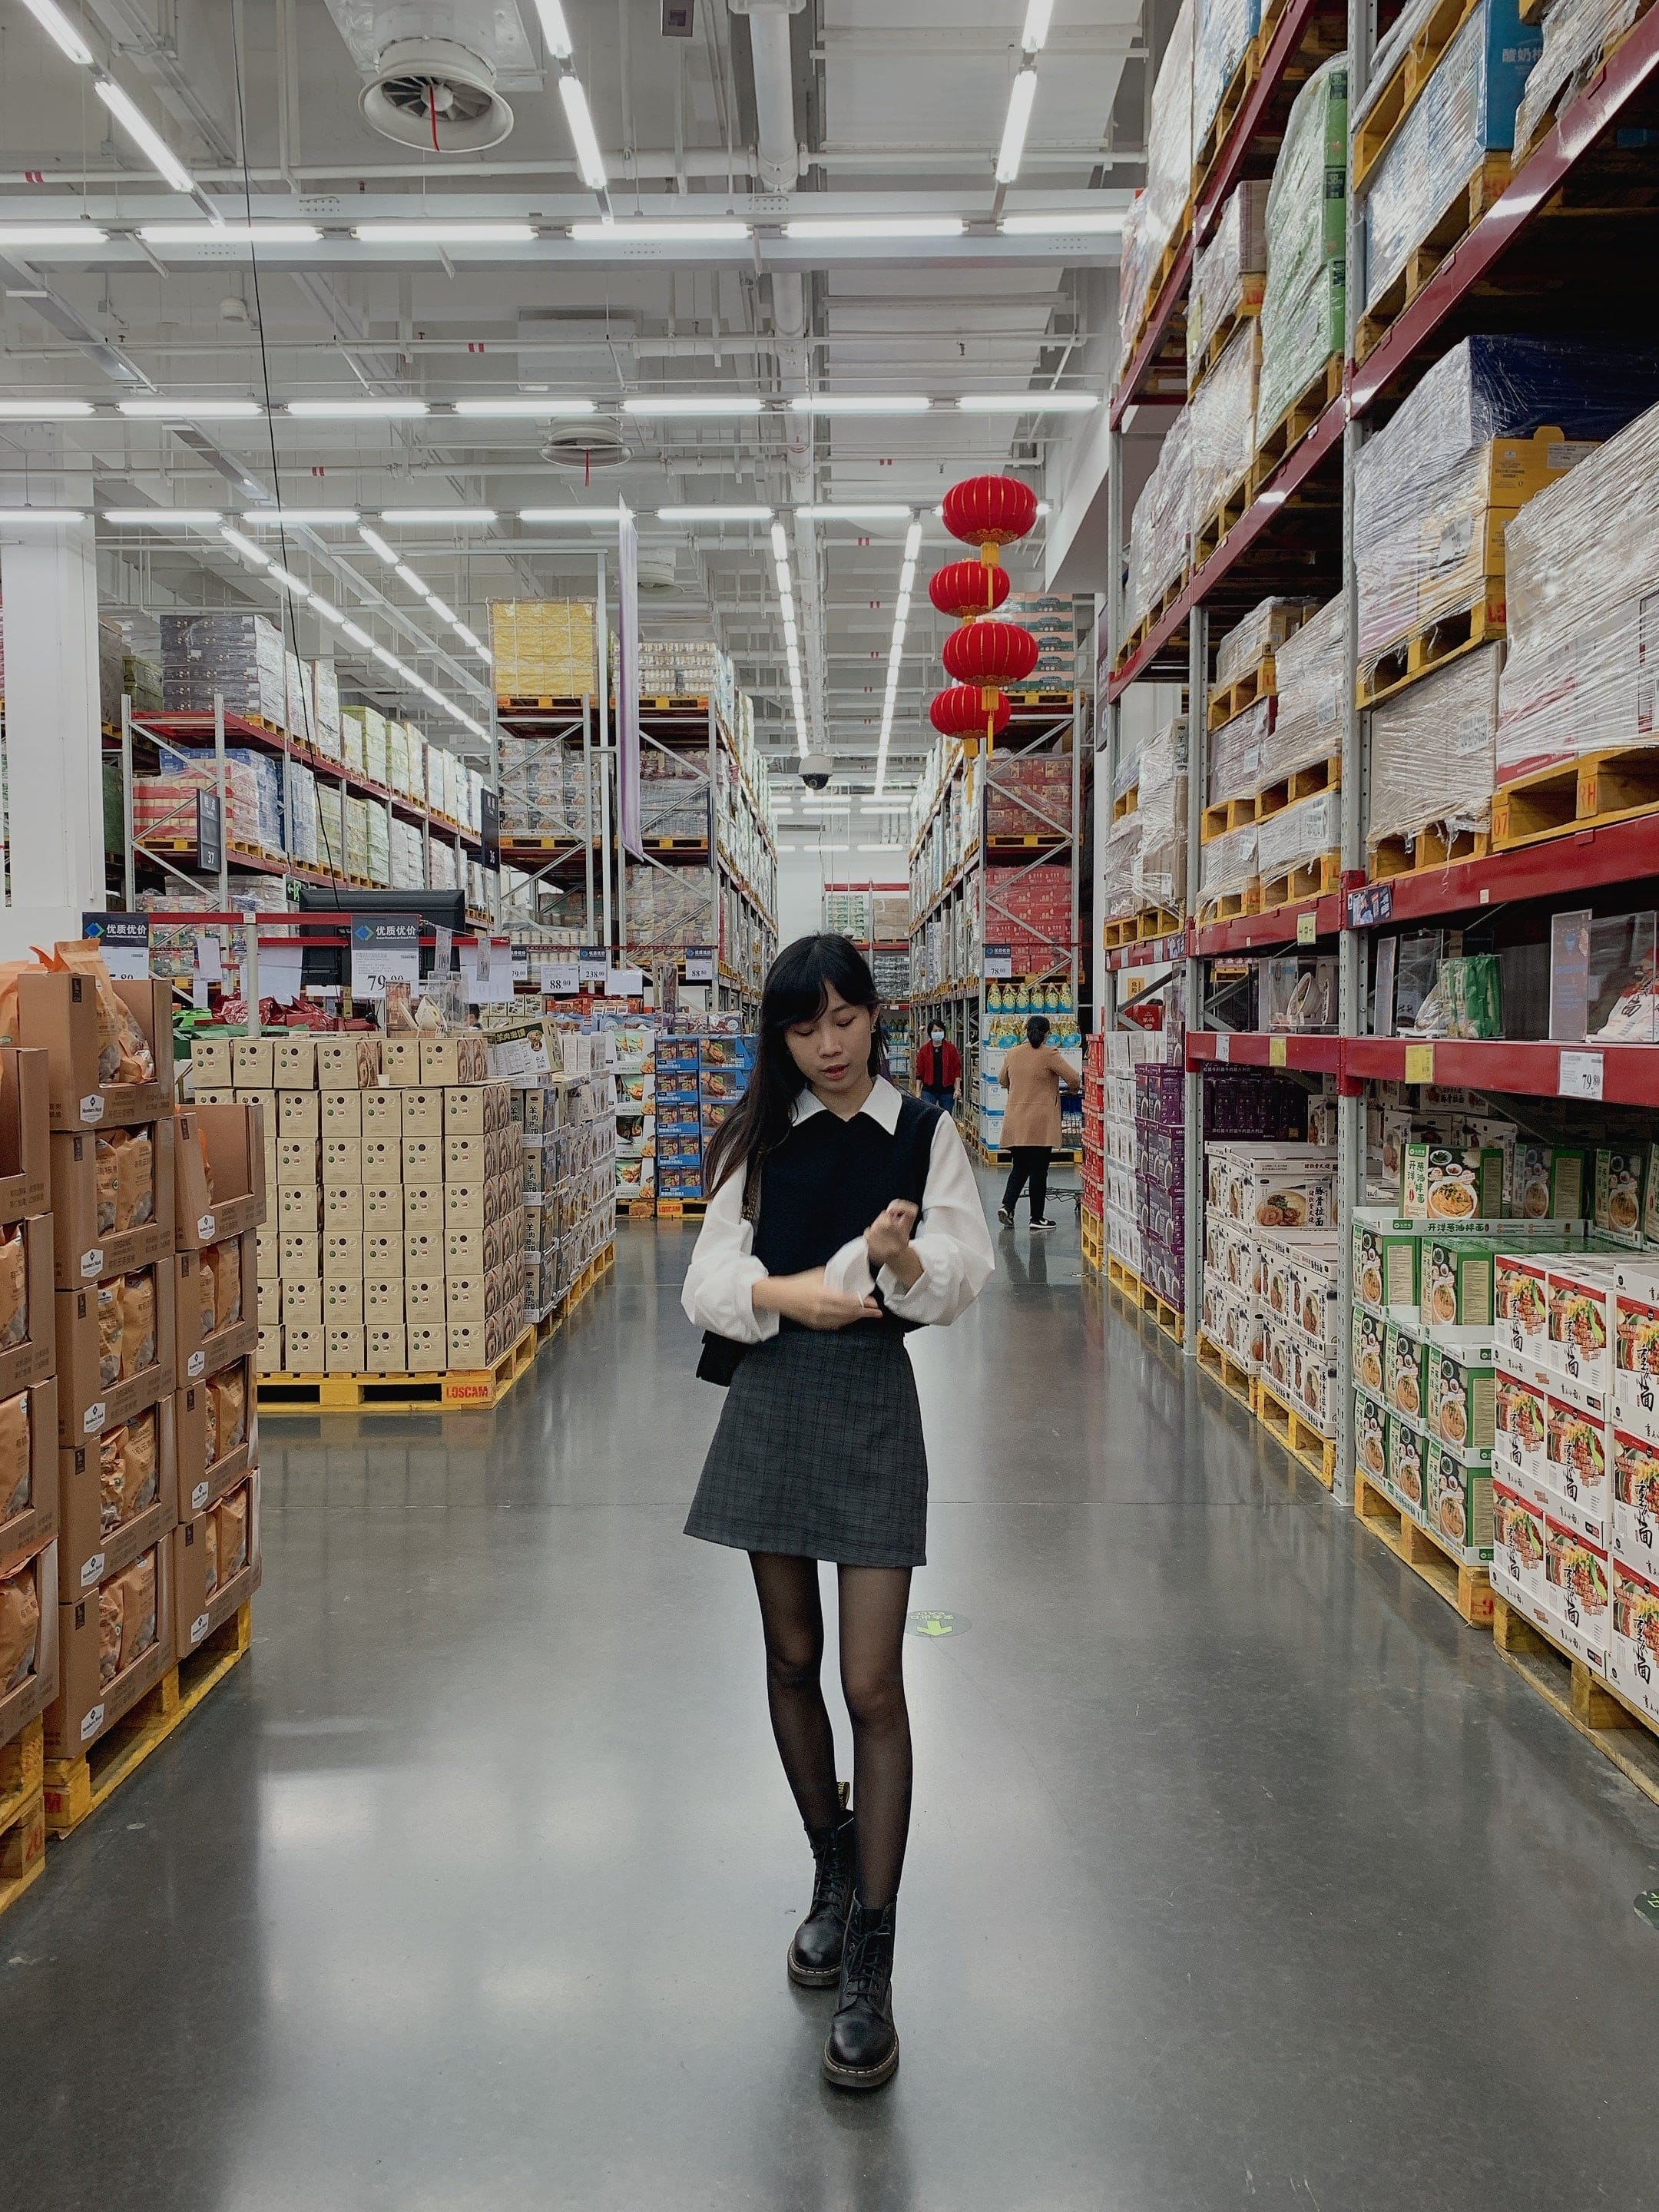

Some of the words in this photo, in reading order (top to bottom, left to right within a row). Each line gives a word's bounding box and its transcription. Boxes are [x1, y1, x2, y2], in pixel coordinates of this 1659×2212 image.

[106, 924, 147, 935] 优质优价
[376, 926, 417, 935] 优质优价
[549, 979, 571, 990] 88.00
[1581, 1074, 1601, 1090] 79.80
[1314, 1185, 1325, 1227] 豚骨拉面
[1427, 1221, 1484, 1233] 开洋葱油拌面
[445, 1386, 488, 1398] LOSCAM
